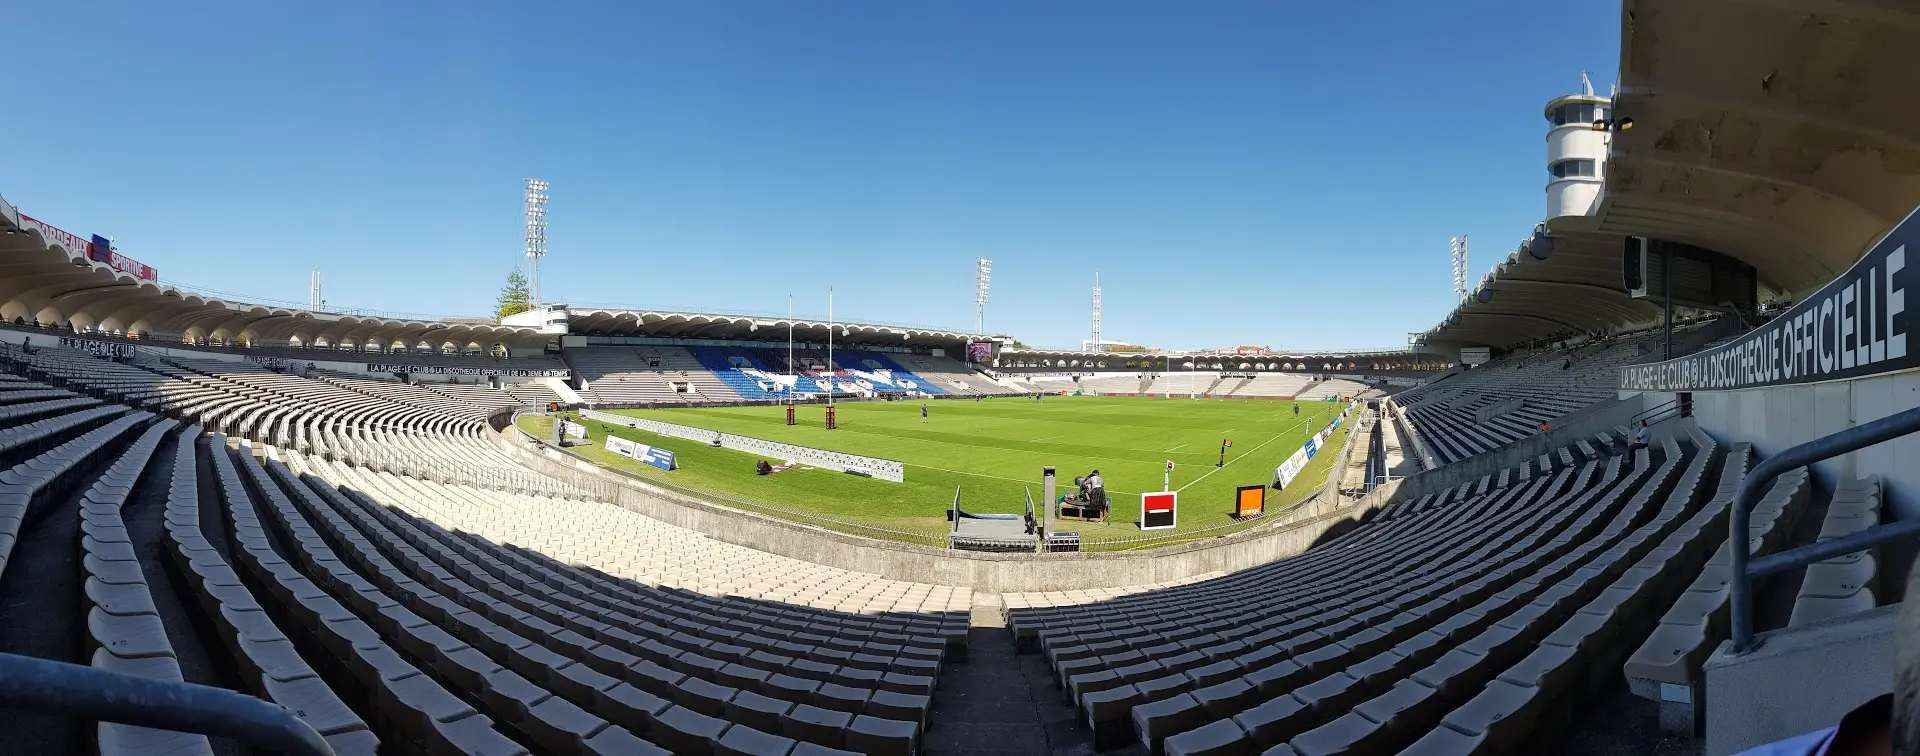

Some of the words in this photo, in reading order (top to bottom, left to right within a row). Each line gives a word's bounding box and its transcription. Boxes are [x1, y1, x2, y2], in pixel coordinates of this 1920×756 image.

[111, 253, 144, 278] SPORTIVE
[1621, 368, 1629, 389] LA
[1667, 360, 1690, 390] CLUB
[1699, 356, 1709, 388] LA
[1710, 327, 1780, 388] DISCOTHEQUE
[1782, 244, 1907, 380] OFFICIELLE
[370, 364, 379, 372] LA
[412, 365, 429, 374] CLUB
[435, 366, 442, 374] LA
[443, 367, 480, 375] DISCOTHEQUE
